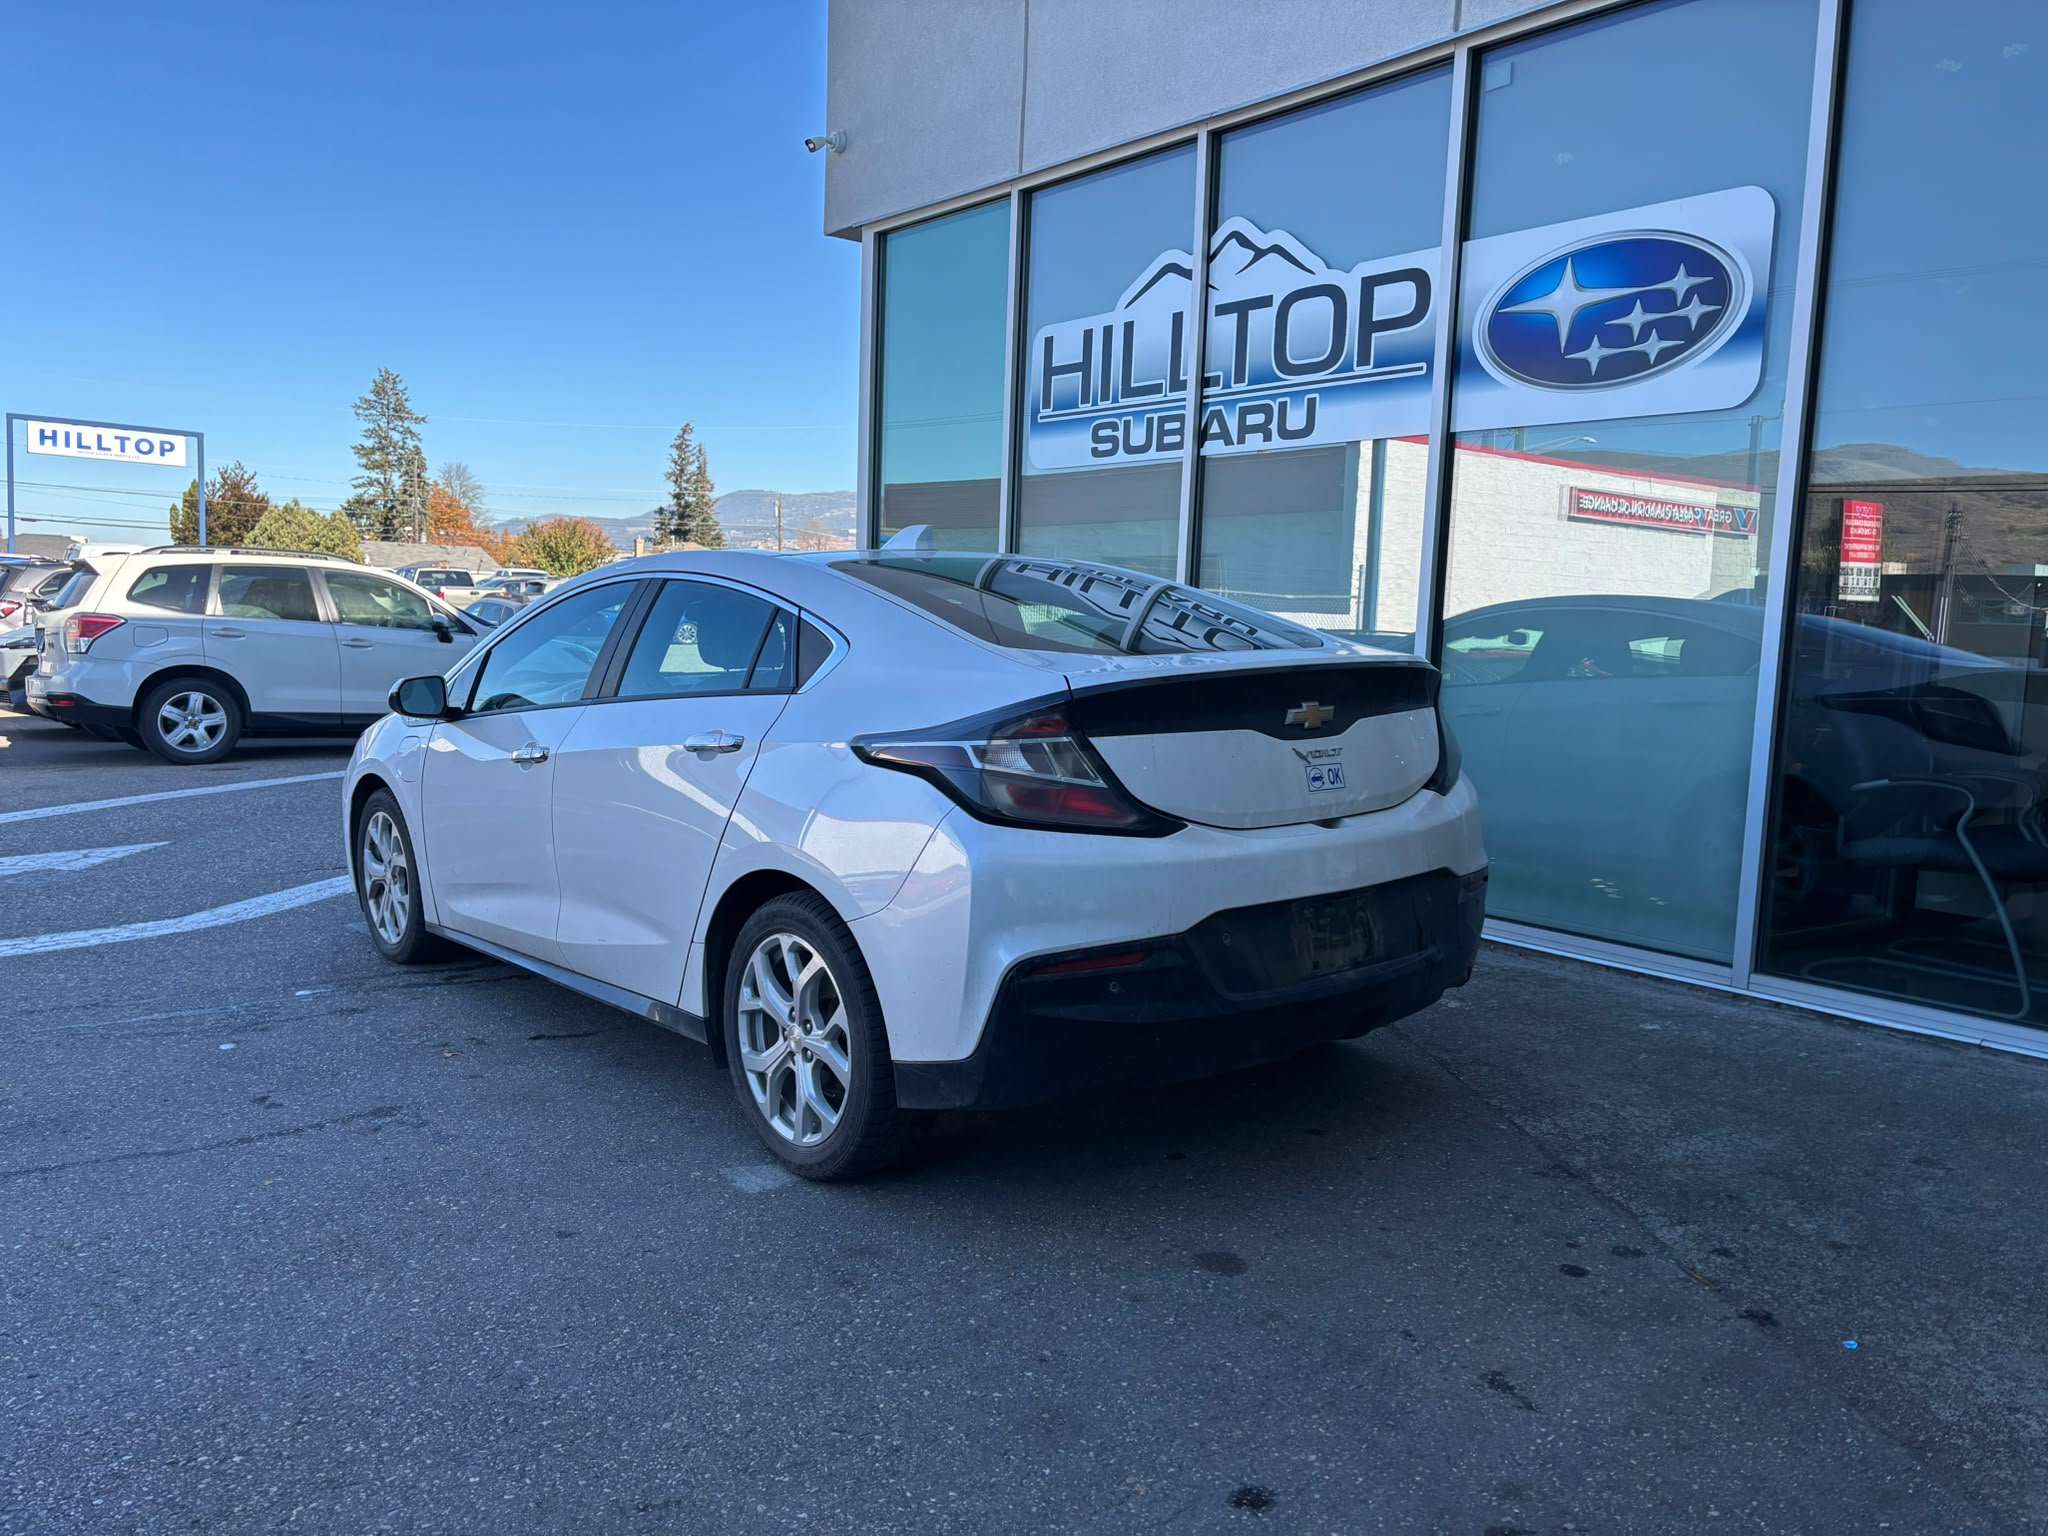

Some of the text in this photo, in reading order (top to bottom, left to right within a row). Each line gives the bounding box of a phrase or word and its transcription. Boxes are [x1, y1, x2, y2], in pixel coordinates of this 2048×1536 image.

[1041, 267, 1431, 410] HILLTOP
[39, 428, 176, 457] HILLTOP
[1090, 397, 1318, 459] SUBARU
[1327, 767, 1343, 785] OK
